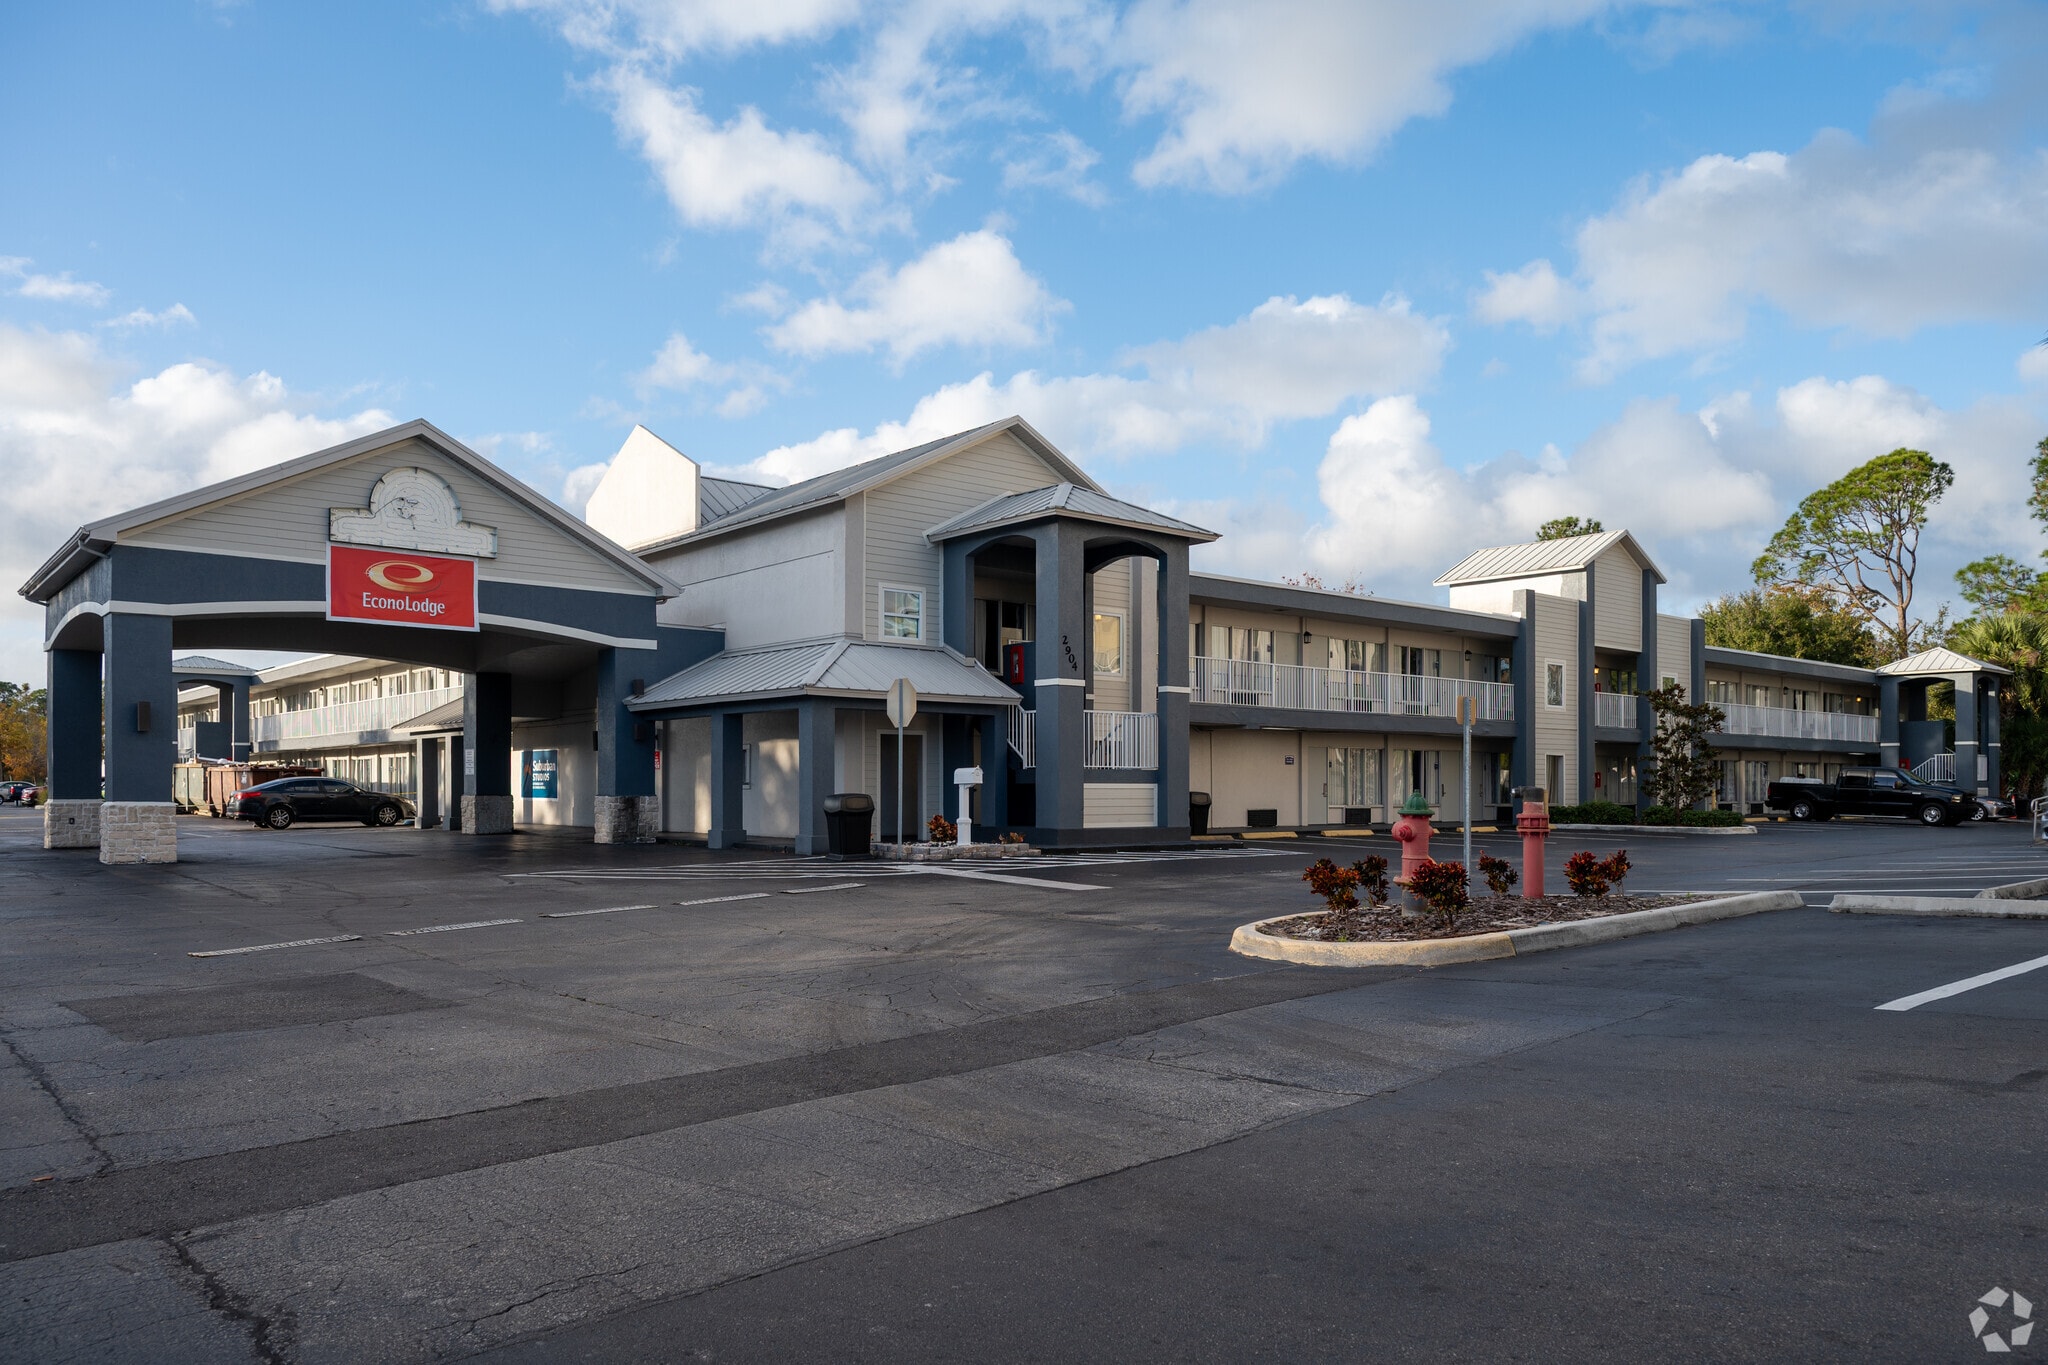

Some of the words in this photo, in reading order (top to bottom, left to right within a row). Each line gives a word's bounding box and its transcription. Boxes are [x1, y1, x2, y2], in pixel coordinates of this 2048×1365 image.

[362, 592, 446, 617] EconoLodge
[1062, 635, 1078, 672] 2904
[533, 760, 556, 772] Suburban
